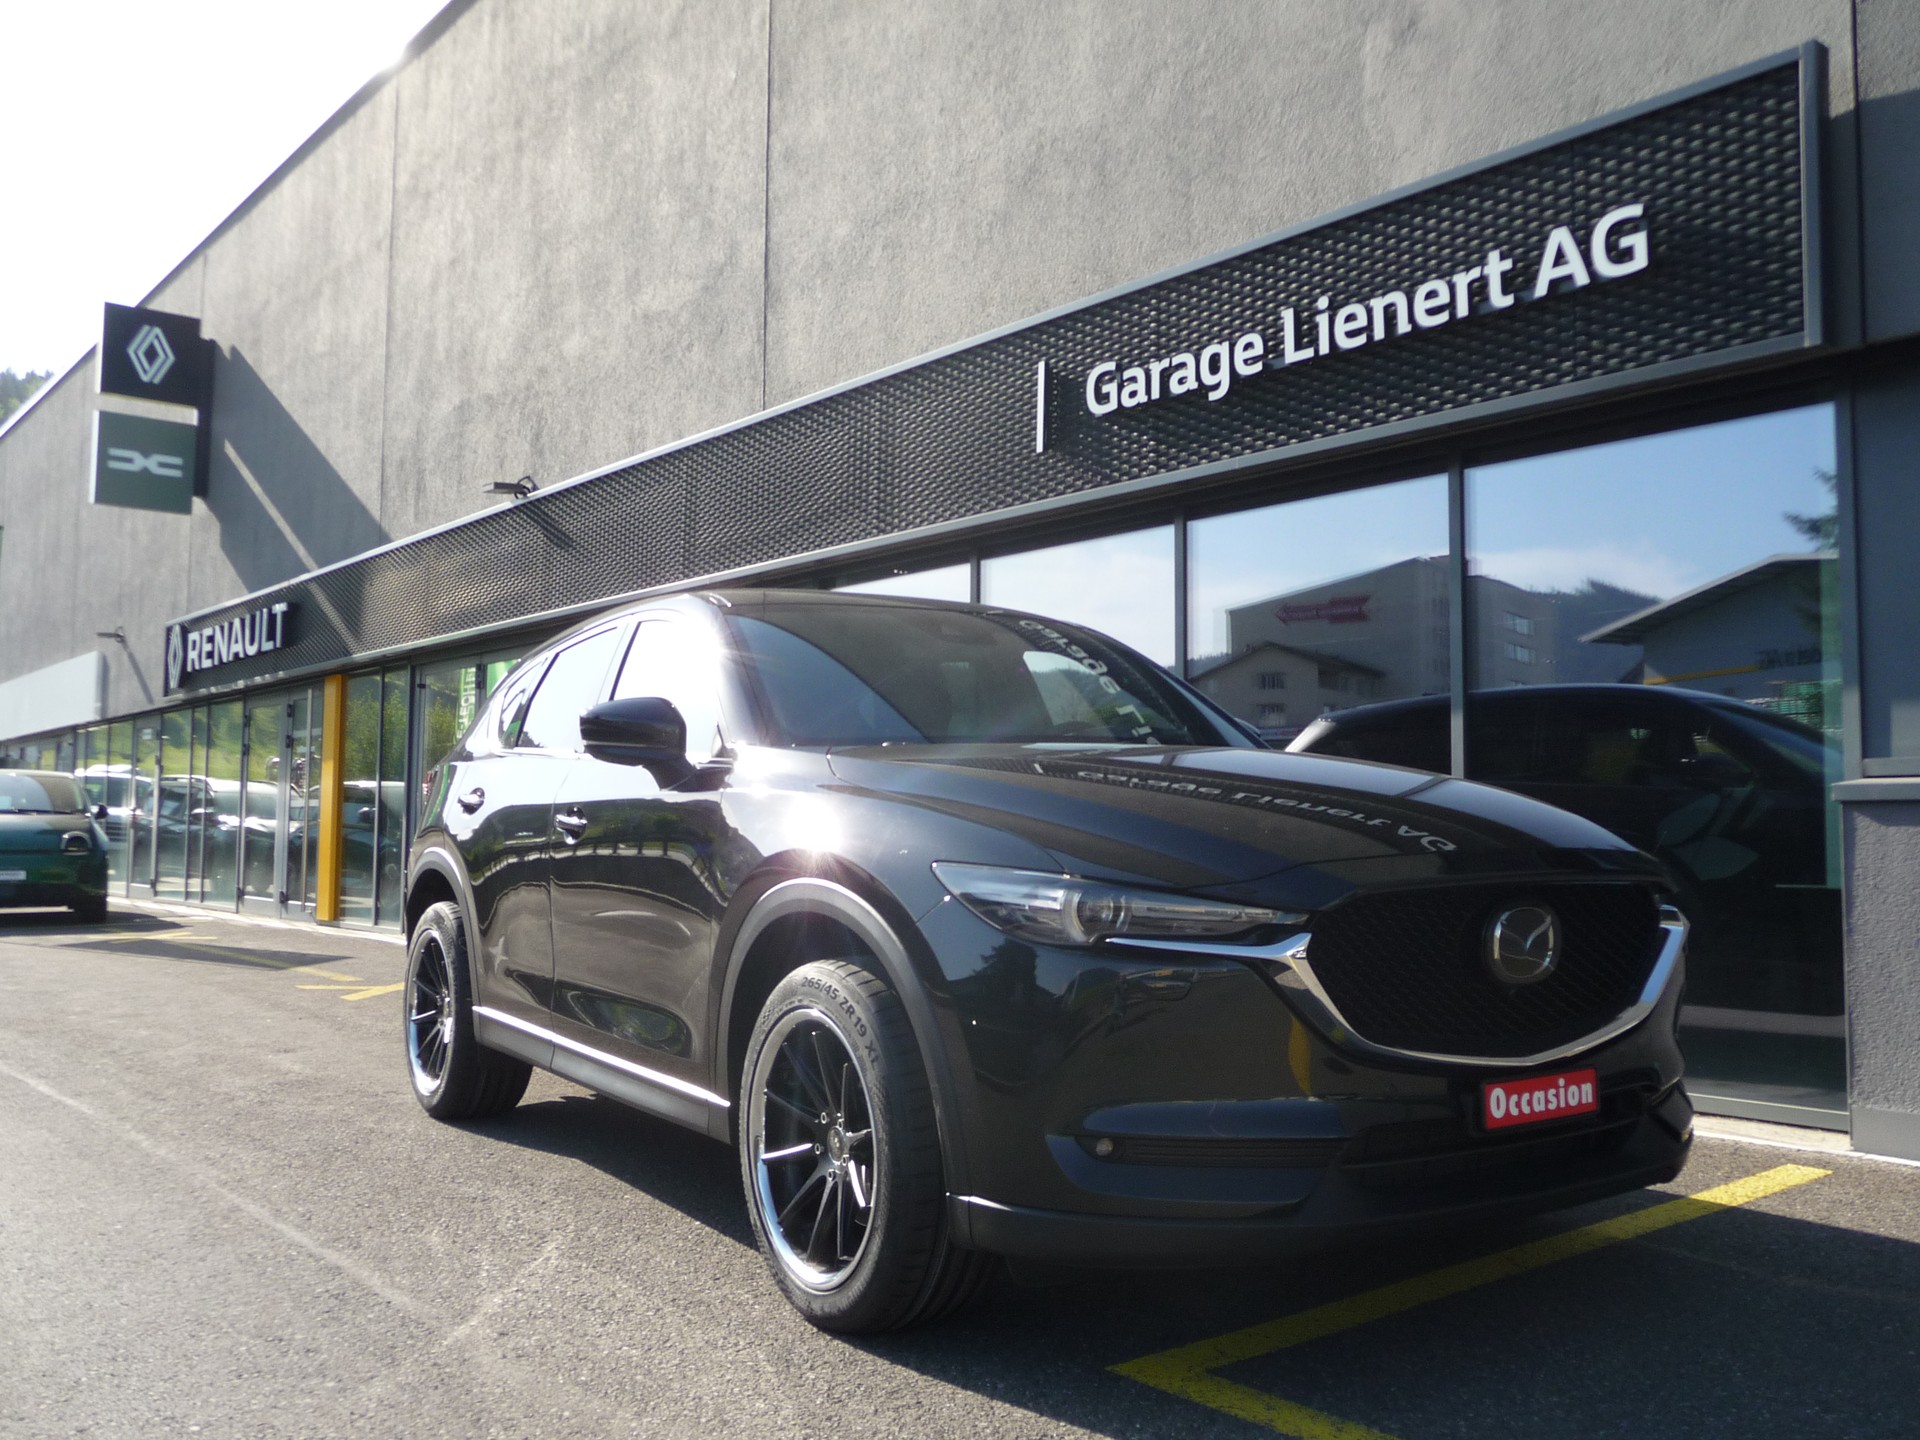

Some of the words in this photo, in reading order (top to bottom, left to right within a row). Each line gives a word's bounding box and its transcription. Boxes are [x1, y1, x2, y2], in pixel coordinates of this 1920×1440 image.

[1086, 331, 1264, 418] Garage
[1281, 248, 1515, 365] Lienert
[1533, 203, 1650, 299] AG
[186, 602, 289, 672] RENAULT
[801, 976, 840, 1000] 265/45
[839, 996, 856, 1019] ZR
[853, 1016, 868, 1038] 19
[1489, 1077, 1593, 1119] Occasion
